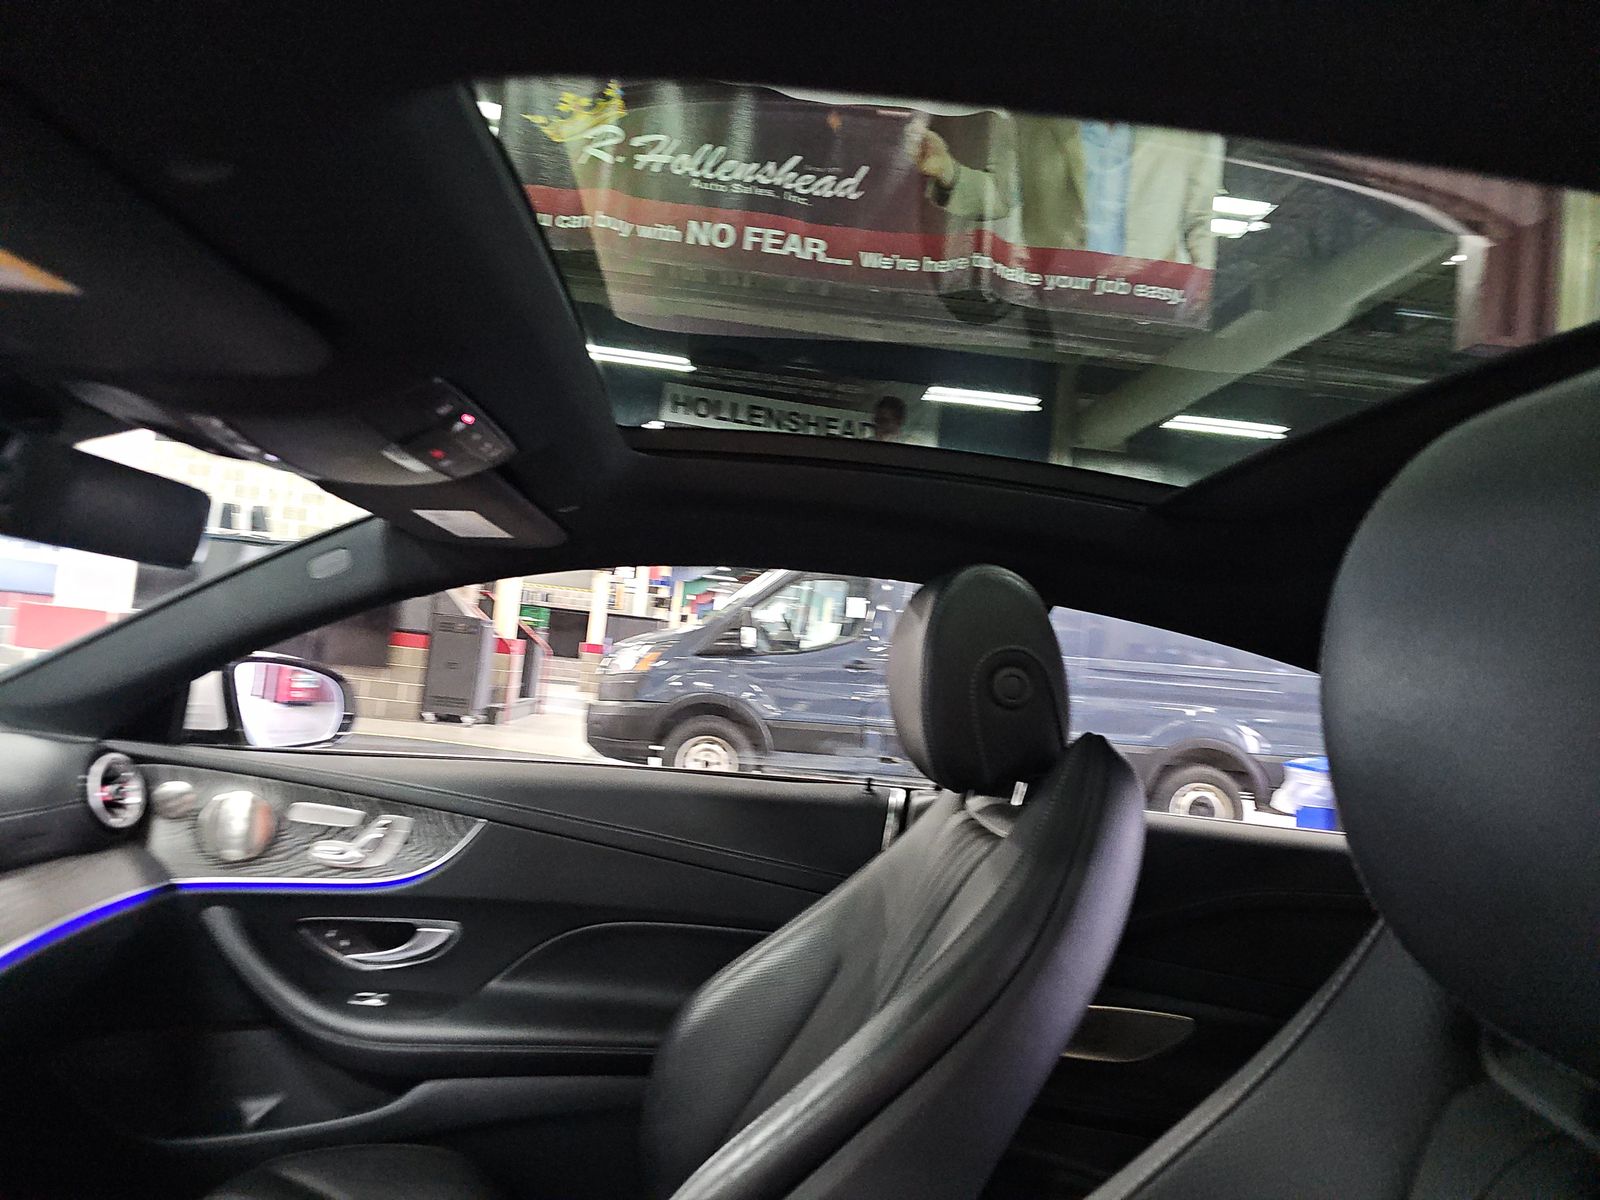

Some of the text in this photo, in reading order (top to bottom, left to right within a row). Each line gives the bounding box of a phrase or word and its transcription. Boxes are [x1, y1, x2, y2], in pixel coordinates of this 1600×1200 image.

[577, 124, 871, 200] R. Hollenshead
[554, 215, 593, 229] can
[593, 211, 635, 237] buy
[636, 223, 682, 242] with
[686, 220, 737, 249] NO
[857, 251, 921, 272] We're
[922, 256, 970, 273] here
[970, 252, 993, 269] to
[993, 262, 1044, 287] make
[1043, 274, 1095, 291] your
[1093, 275, 1132, 296] job
